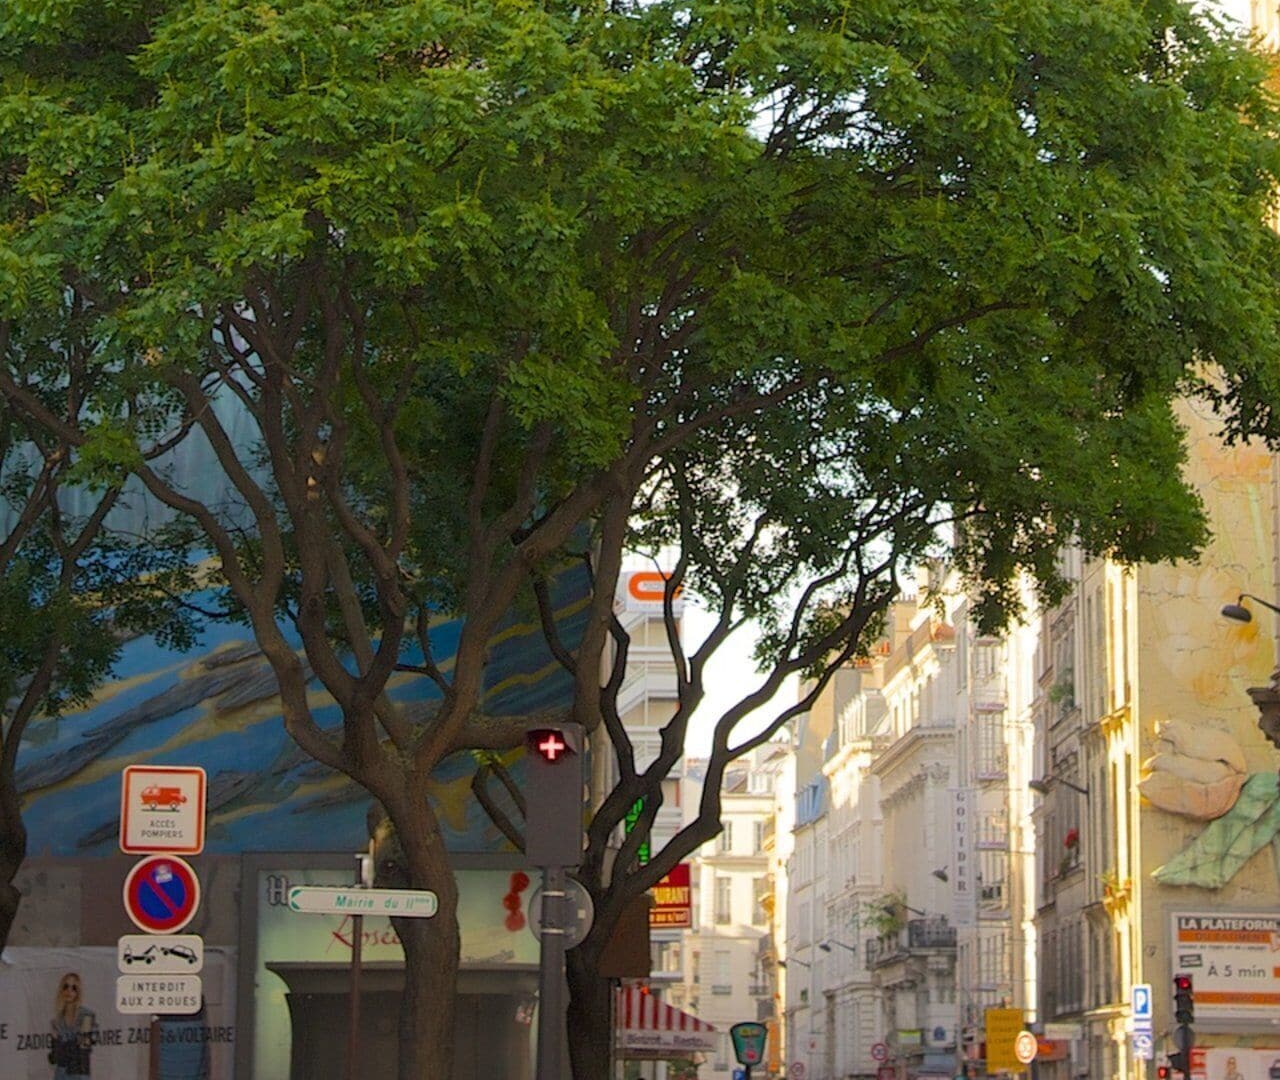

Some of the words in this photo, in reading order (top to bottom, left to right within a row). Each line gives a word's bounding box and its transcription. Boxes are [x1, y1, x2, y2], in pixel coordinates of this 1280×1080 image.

[141, 829, 184, 839] POMPIERS
[335, 895, 374, 908] Mairie
[384, 896, 400, 909] du
[1180, 918, 1198, 930] LA
[1224, 965, 1233, 977] 5
[1238, 965, 1266, 978] min
[132, 982, 186, 992] INTERDIT
[121, 996, 143, 1006] AUX
[147, 996, 154, 1006] 2
[158, 996, 197, 1007] ROUES
[127, 1026, 164, 1044] ZAD
